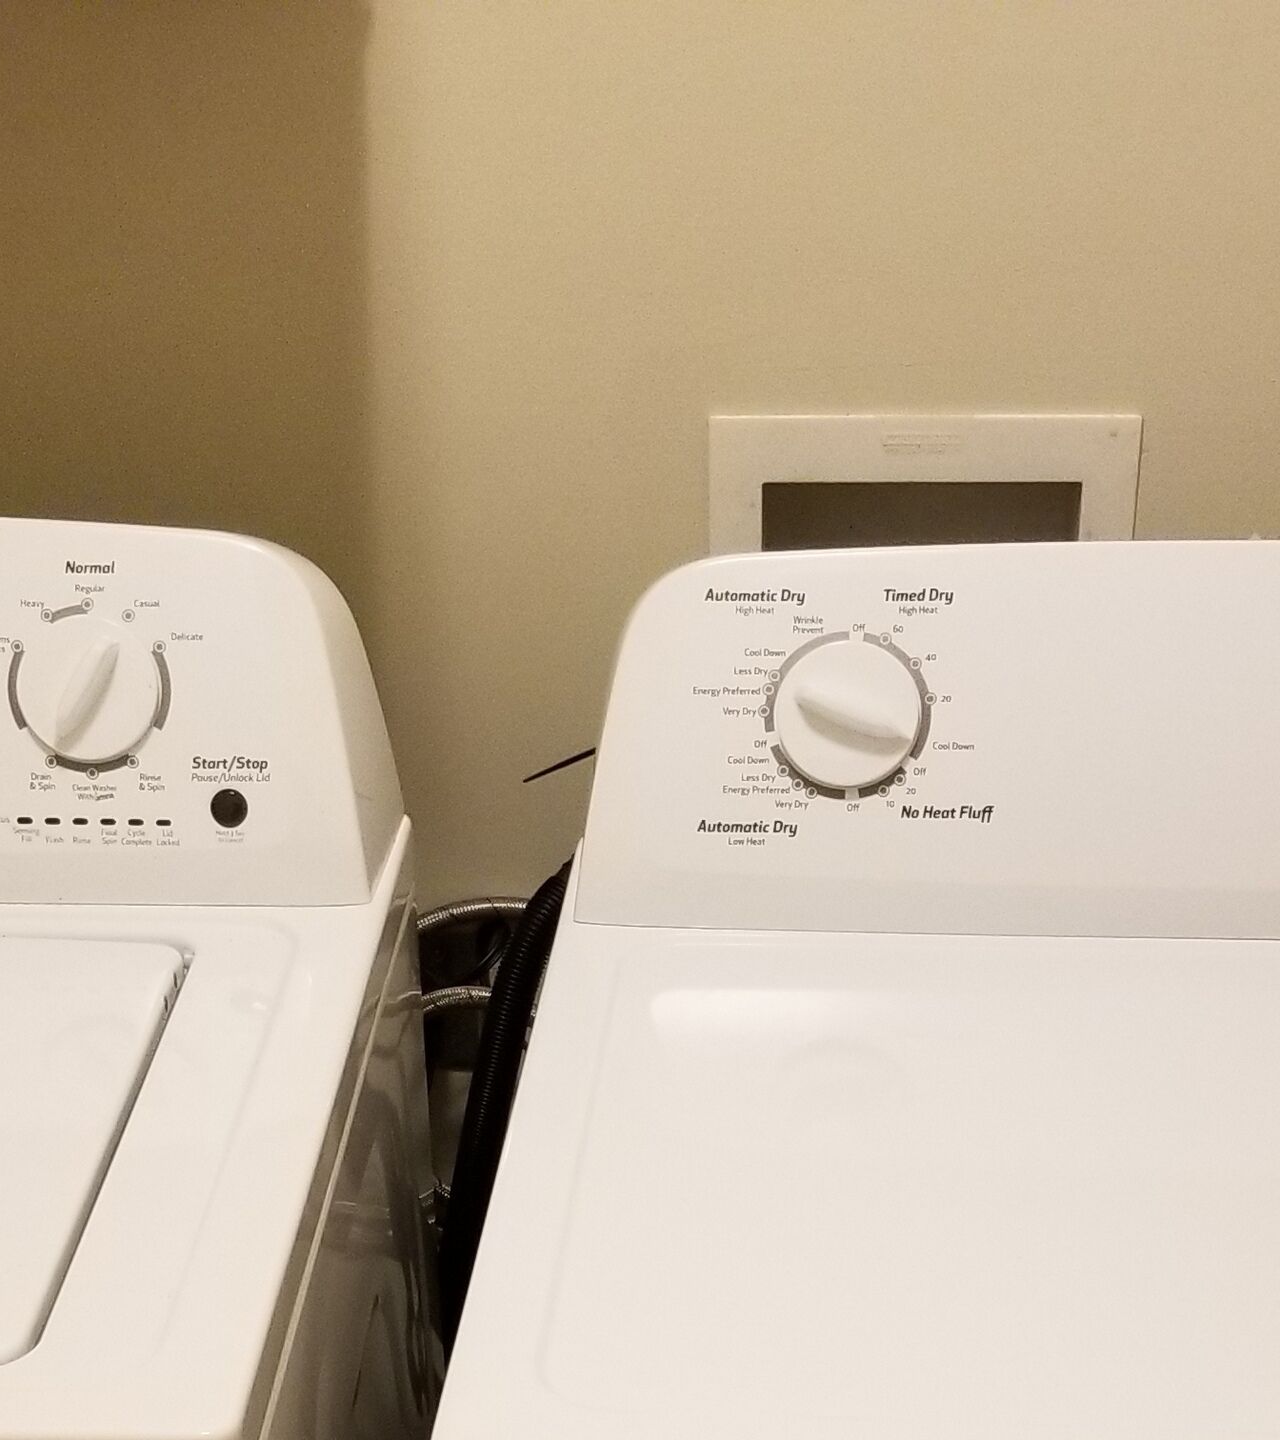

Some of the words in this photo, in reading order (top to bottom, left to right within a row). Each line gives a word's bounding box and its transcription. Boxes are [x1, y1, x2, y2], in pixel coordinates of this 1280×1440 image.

[65, 561, 115, 574] Normal
[75, 585, 104, 594] Regular
[705, 589, 777, 602] Automatic
[781, 590, 805, 606] Dry
[884, 589, 925, 601] Timed
[929, 589, 954, 605] Dry
[20, 600, 45, 609] Heavy
[134, 600, 160, 608] Casual
[735, 606, 753, 616] High
[755, 606, 774, 614] Heat
[899, 606, 916, 615] High
[919, 606, 938, 614] Heat
[793, 616, 823, 625] Wrinkle
[793, 626, 824, 634] Prevent
[852, 623, 865, 632] Off
[893, 625, 903, 633] 60
[171, 633, 203, 641] Delicate
[744, 649, 762, 657] Cool
[764, 649, 786, 657] Down
[925, 653, 936, 661] 40
[734, 667, 751, 675] Less
[754, 667, 767, 677] Dry
[693, 687, 721, 697] Energy
[723, 687, 761, 695] Preferred
[723, 708, 741, 717] Very
[743, 708, 757, 717] Dry
[754, 740, 767, 748] Off
[933, 742, 950, 750] Cool
[192, 756, 268, 772] Start/Stop
[728, 756, 745, 764] Cool
[913, 768, 926, 776] Off
[191, 773, 254, 784] Pause/Unlock
[256, 773, 270, 782] Lid
[741, 774, 759, 782] Less
[761, 774, 775, 783] Dry
[38, 782, 55, 791] Spin
[147, 783, 165, 792] Spin
[722, 786, 750, 796] Energy
[752, 786, 790, 794] Preferred
[906, 787, 916, 795] 20
[775, 801, 792, 810] Very
[794, 801, 808, 810] Dry
[847, 803, 860, 812] Off
[901, 806, 920, 819] No
[923, 806, 956, 819] Heat
[959, 806, 994, 823] Fluff
[697, 821, 769, 834] Automatic
[774, 821, 798, 837] Dry
[121, 838, 152, 847] Complete
[156, 838, 180, 846] Locked
[728, 838, 744, 846] Low
[746, 838, 765, 846] Heat
